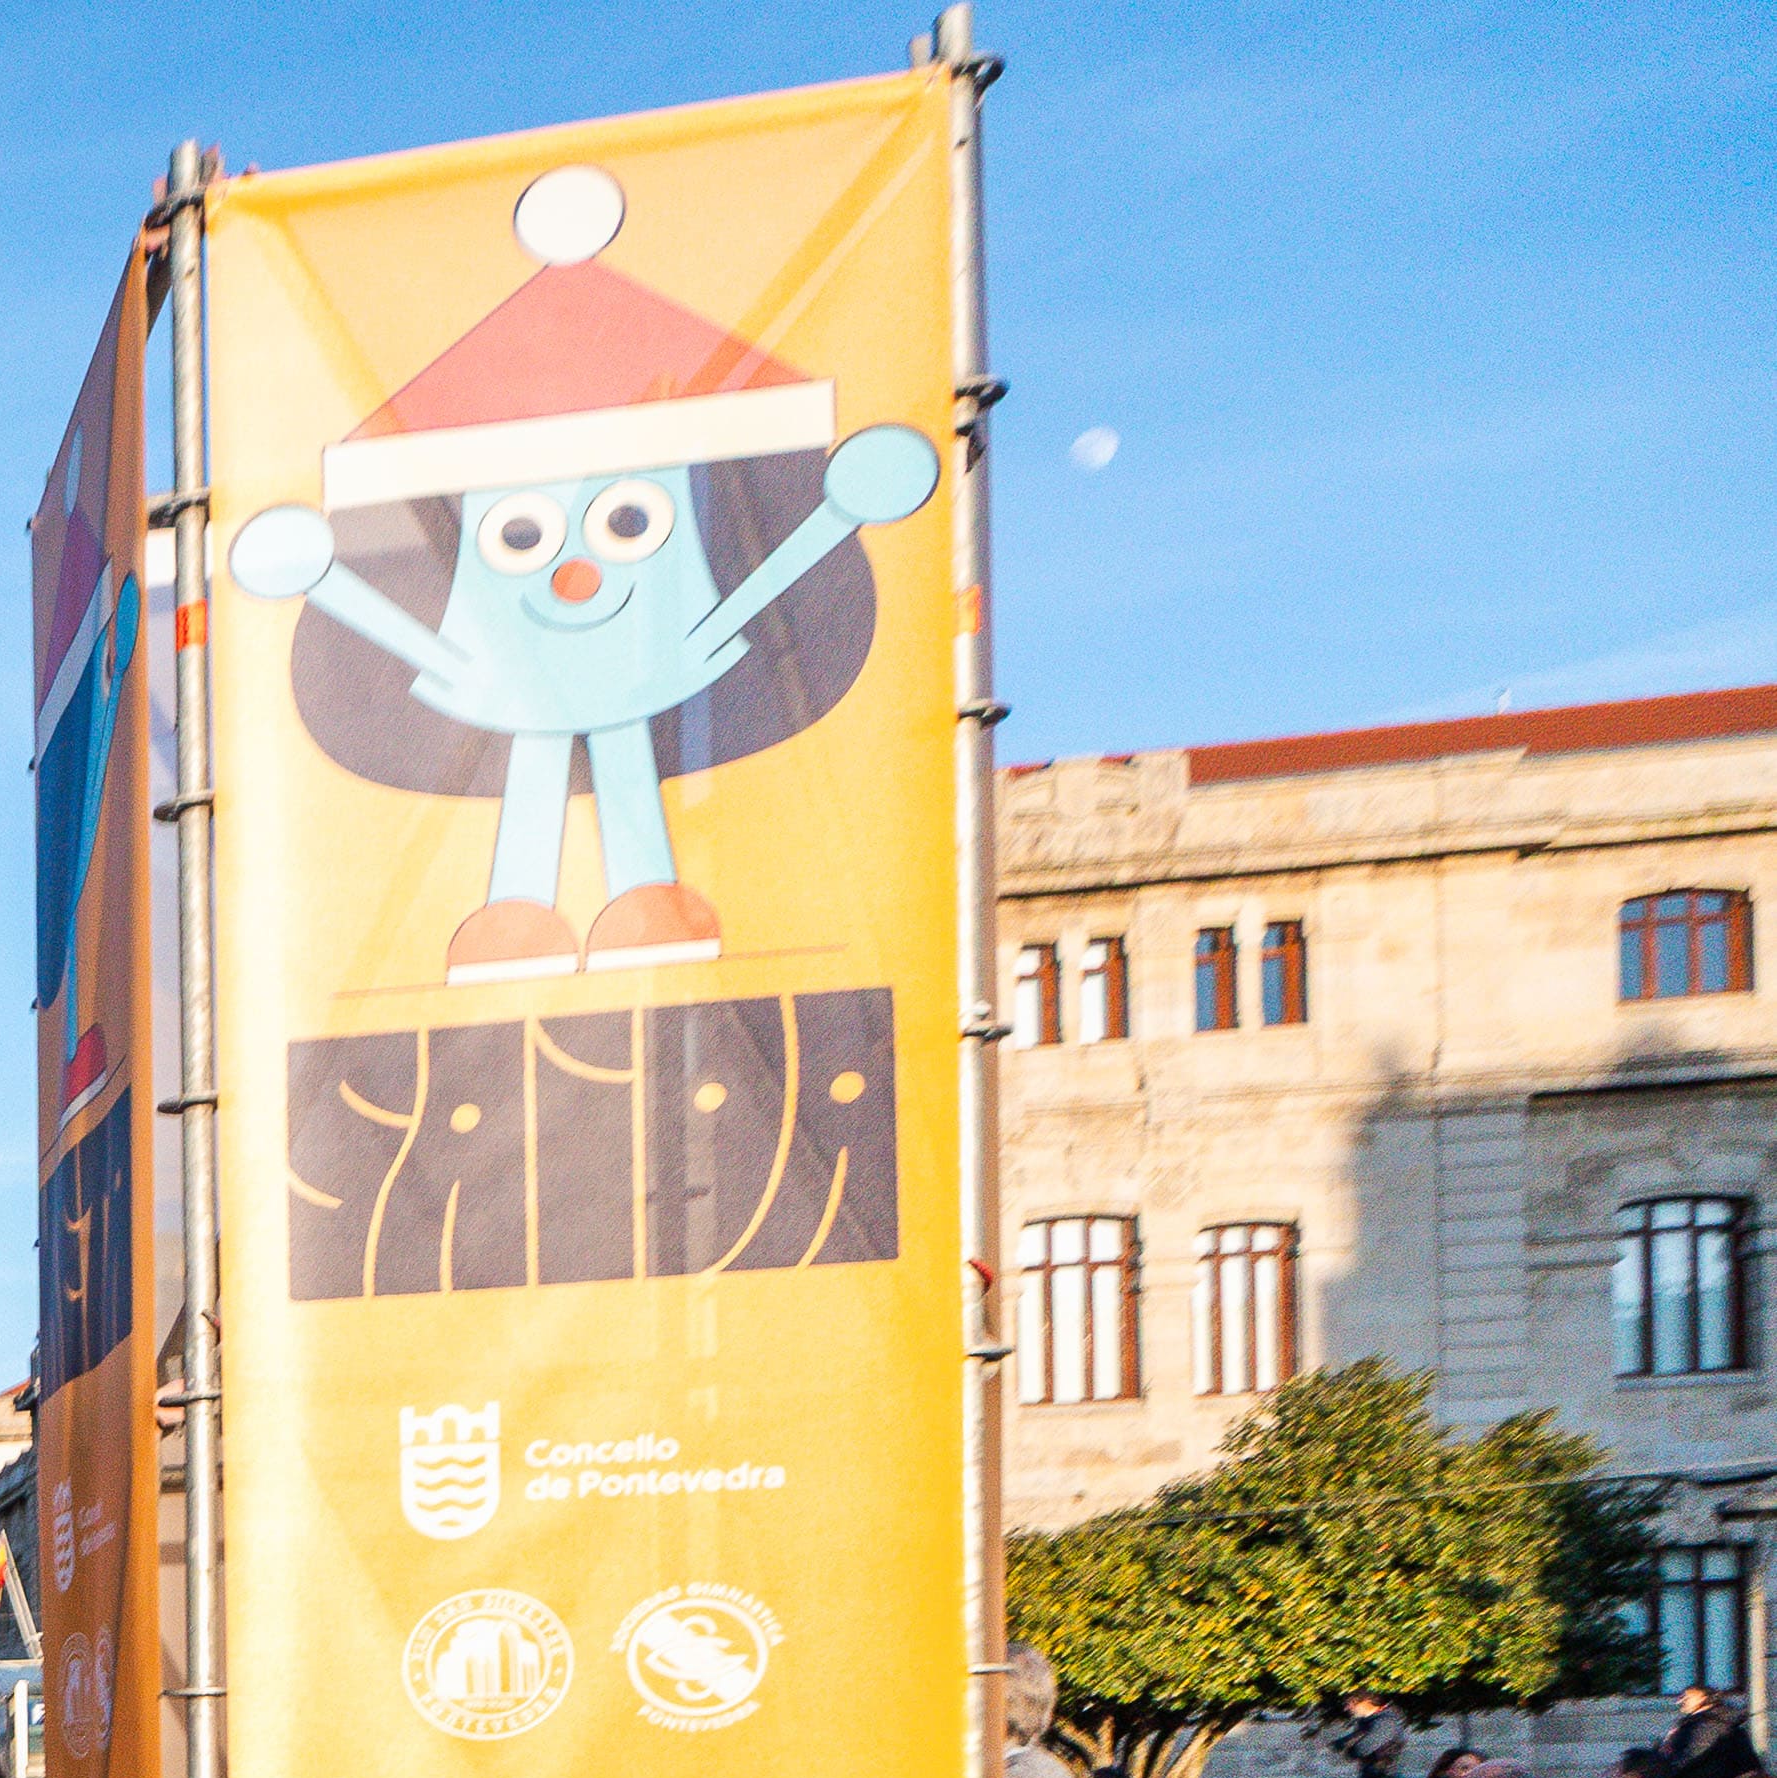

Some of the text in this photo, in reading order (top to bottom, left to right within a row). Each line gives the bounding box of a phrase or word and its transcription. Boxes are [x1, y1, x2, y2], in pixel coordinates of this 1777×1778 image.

[524, 1433, 680, 1467] Concello
[524, 1462, 786, 1500] de Pontevedra
